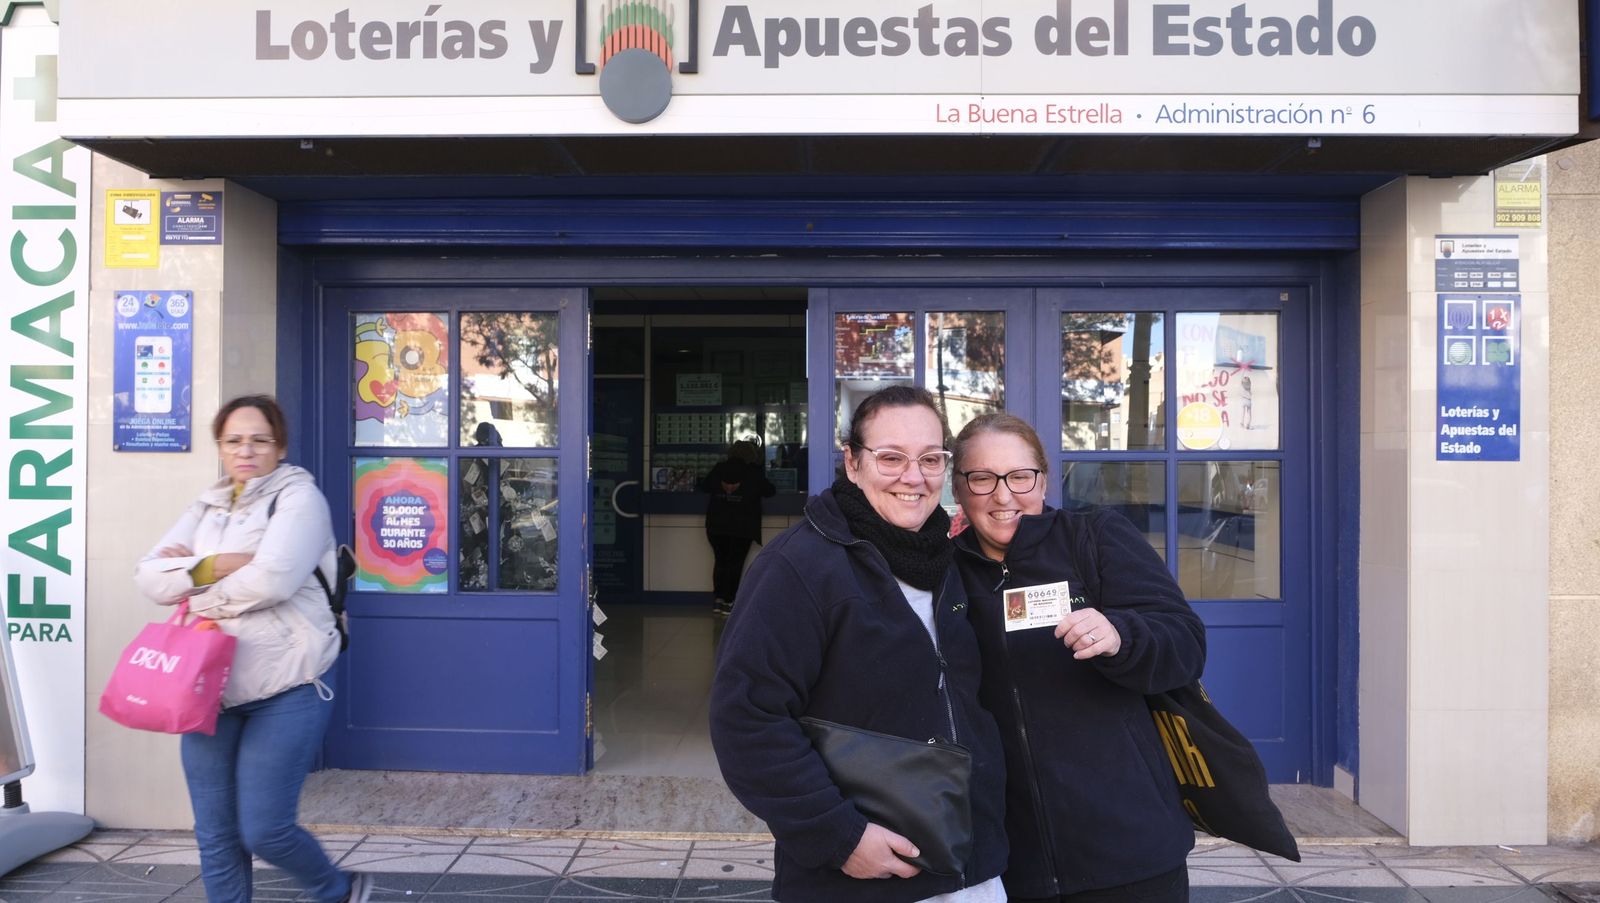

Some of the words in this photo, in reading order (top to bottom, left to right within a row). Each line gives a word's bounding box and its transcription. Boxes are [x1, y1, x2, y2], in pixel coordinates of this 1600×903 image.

[256, 5, 508, 60] Loterías
[529, 21, 563, 75] y
[713, 4, 1013, 69] Apuestas
[1035, 4, 1129, 57] del
[1153, 4, 1377, 57] Estado
[936, 103, 960, 123] La
[968, 103, 1038, 124] Buena
[1046, 103, 1122, 124] Estrella
[1155, 102, 1323, 125] Administración
[1362, 104, 1376, 125] 6
[1498, 184, 1540, 193] ALARMA
[122, 297, 134, 307] 24
[8, 138, 77, 619] FARMACIA
[1441, 405, 1489, 418] Loterías
[1492, 408, 1500, 420] y
[1441, 424, 1495, 438] Apuestas
[1498, 424, 1517, 436] del
[1441, 442, 1482, 454] Estado
[385, 496, 422, 504] AHORA
[386, 517, 400, 526] AL
[400, 517, 420, 526] MES
[380, 528, 426, 537] DURANTE
[383, 539, 396, 548] 30
[397, 537, 423, 548] AÑOS
[1027, 588, 1057, 599] 60649
[7, 622, 73, 643] PARA
